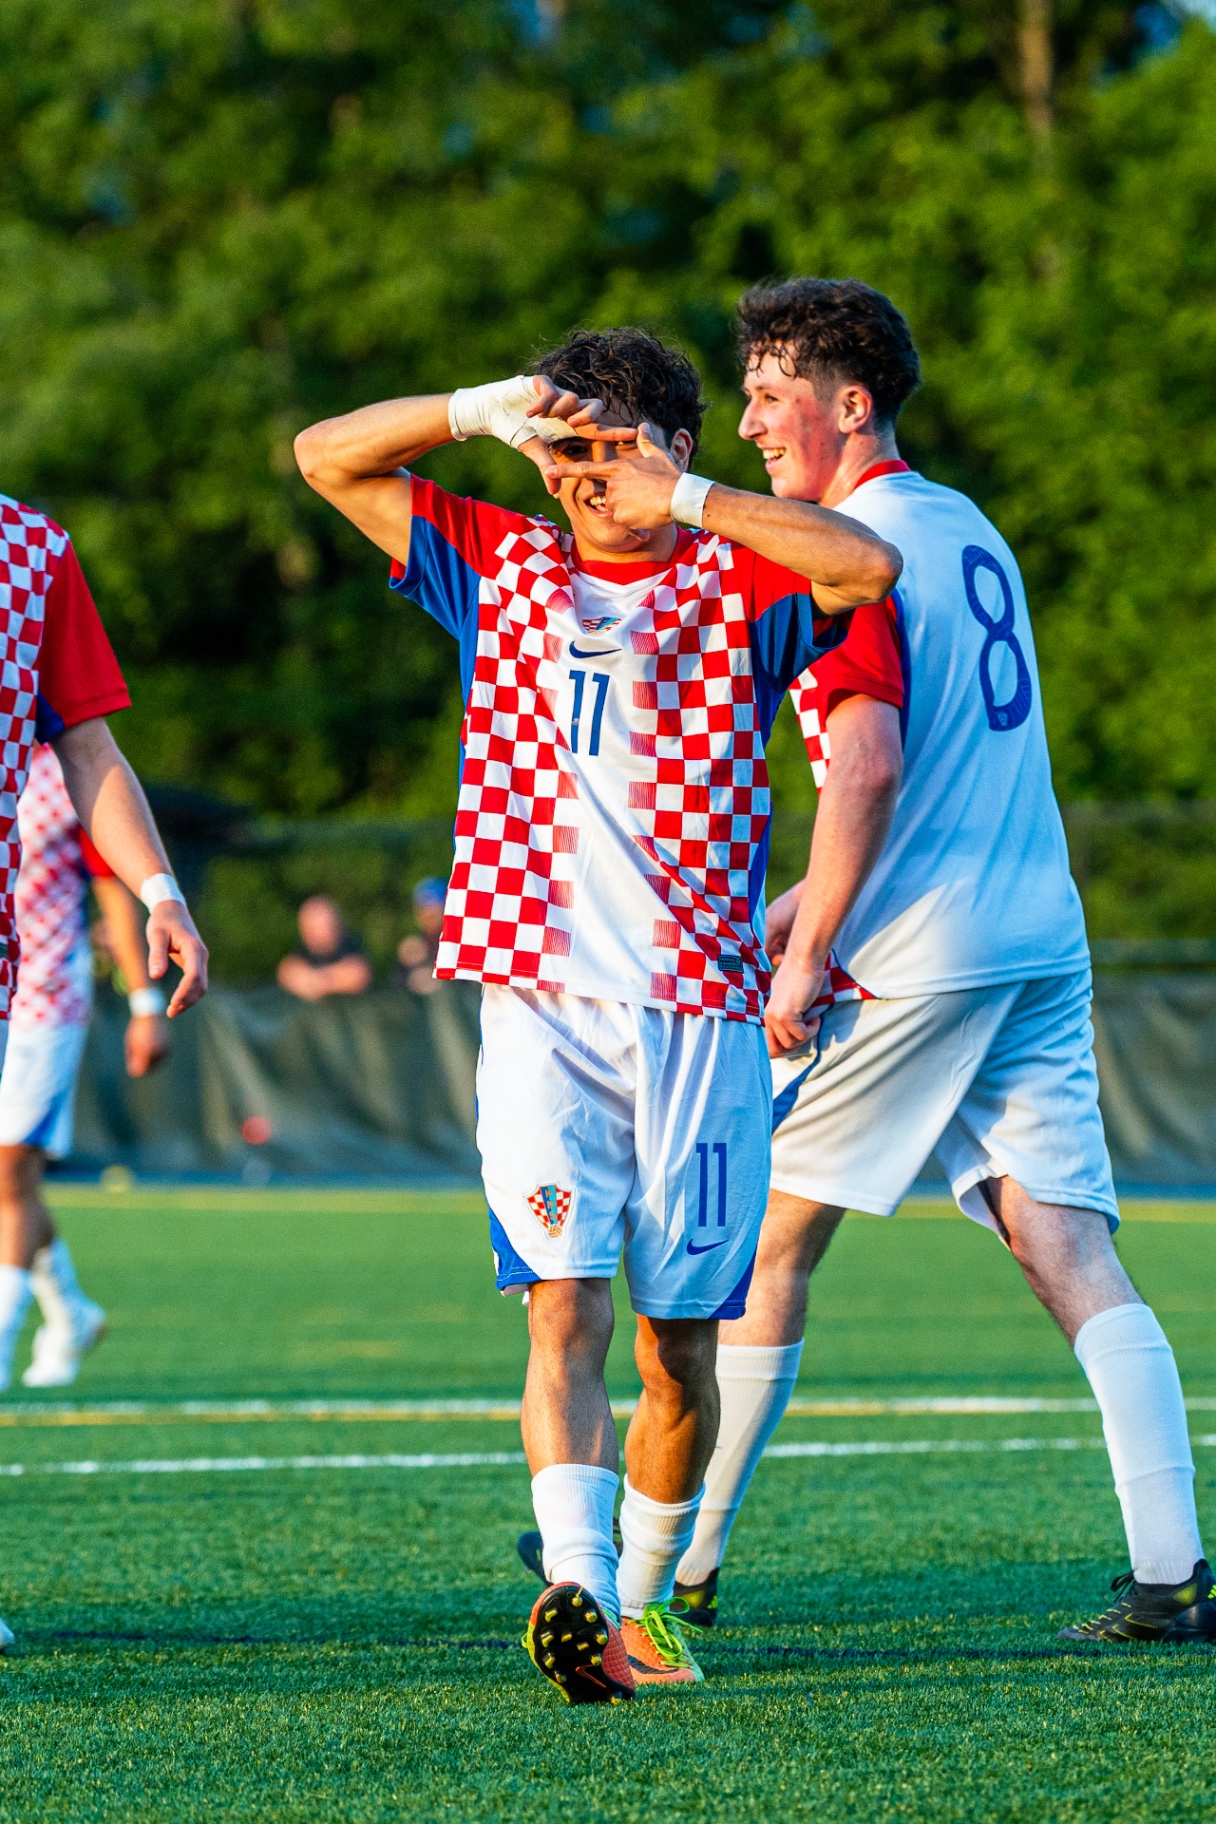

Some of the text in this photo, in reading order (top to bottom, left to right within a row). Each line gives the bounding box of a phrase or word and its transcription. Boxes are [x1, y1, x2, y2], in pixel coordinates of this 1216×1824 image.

[961, 544, 1033, 732] 8
[569, 669, 611, 756] 11
[695, 1142, 728, 1227] 11
